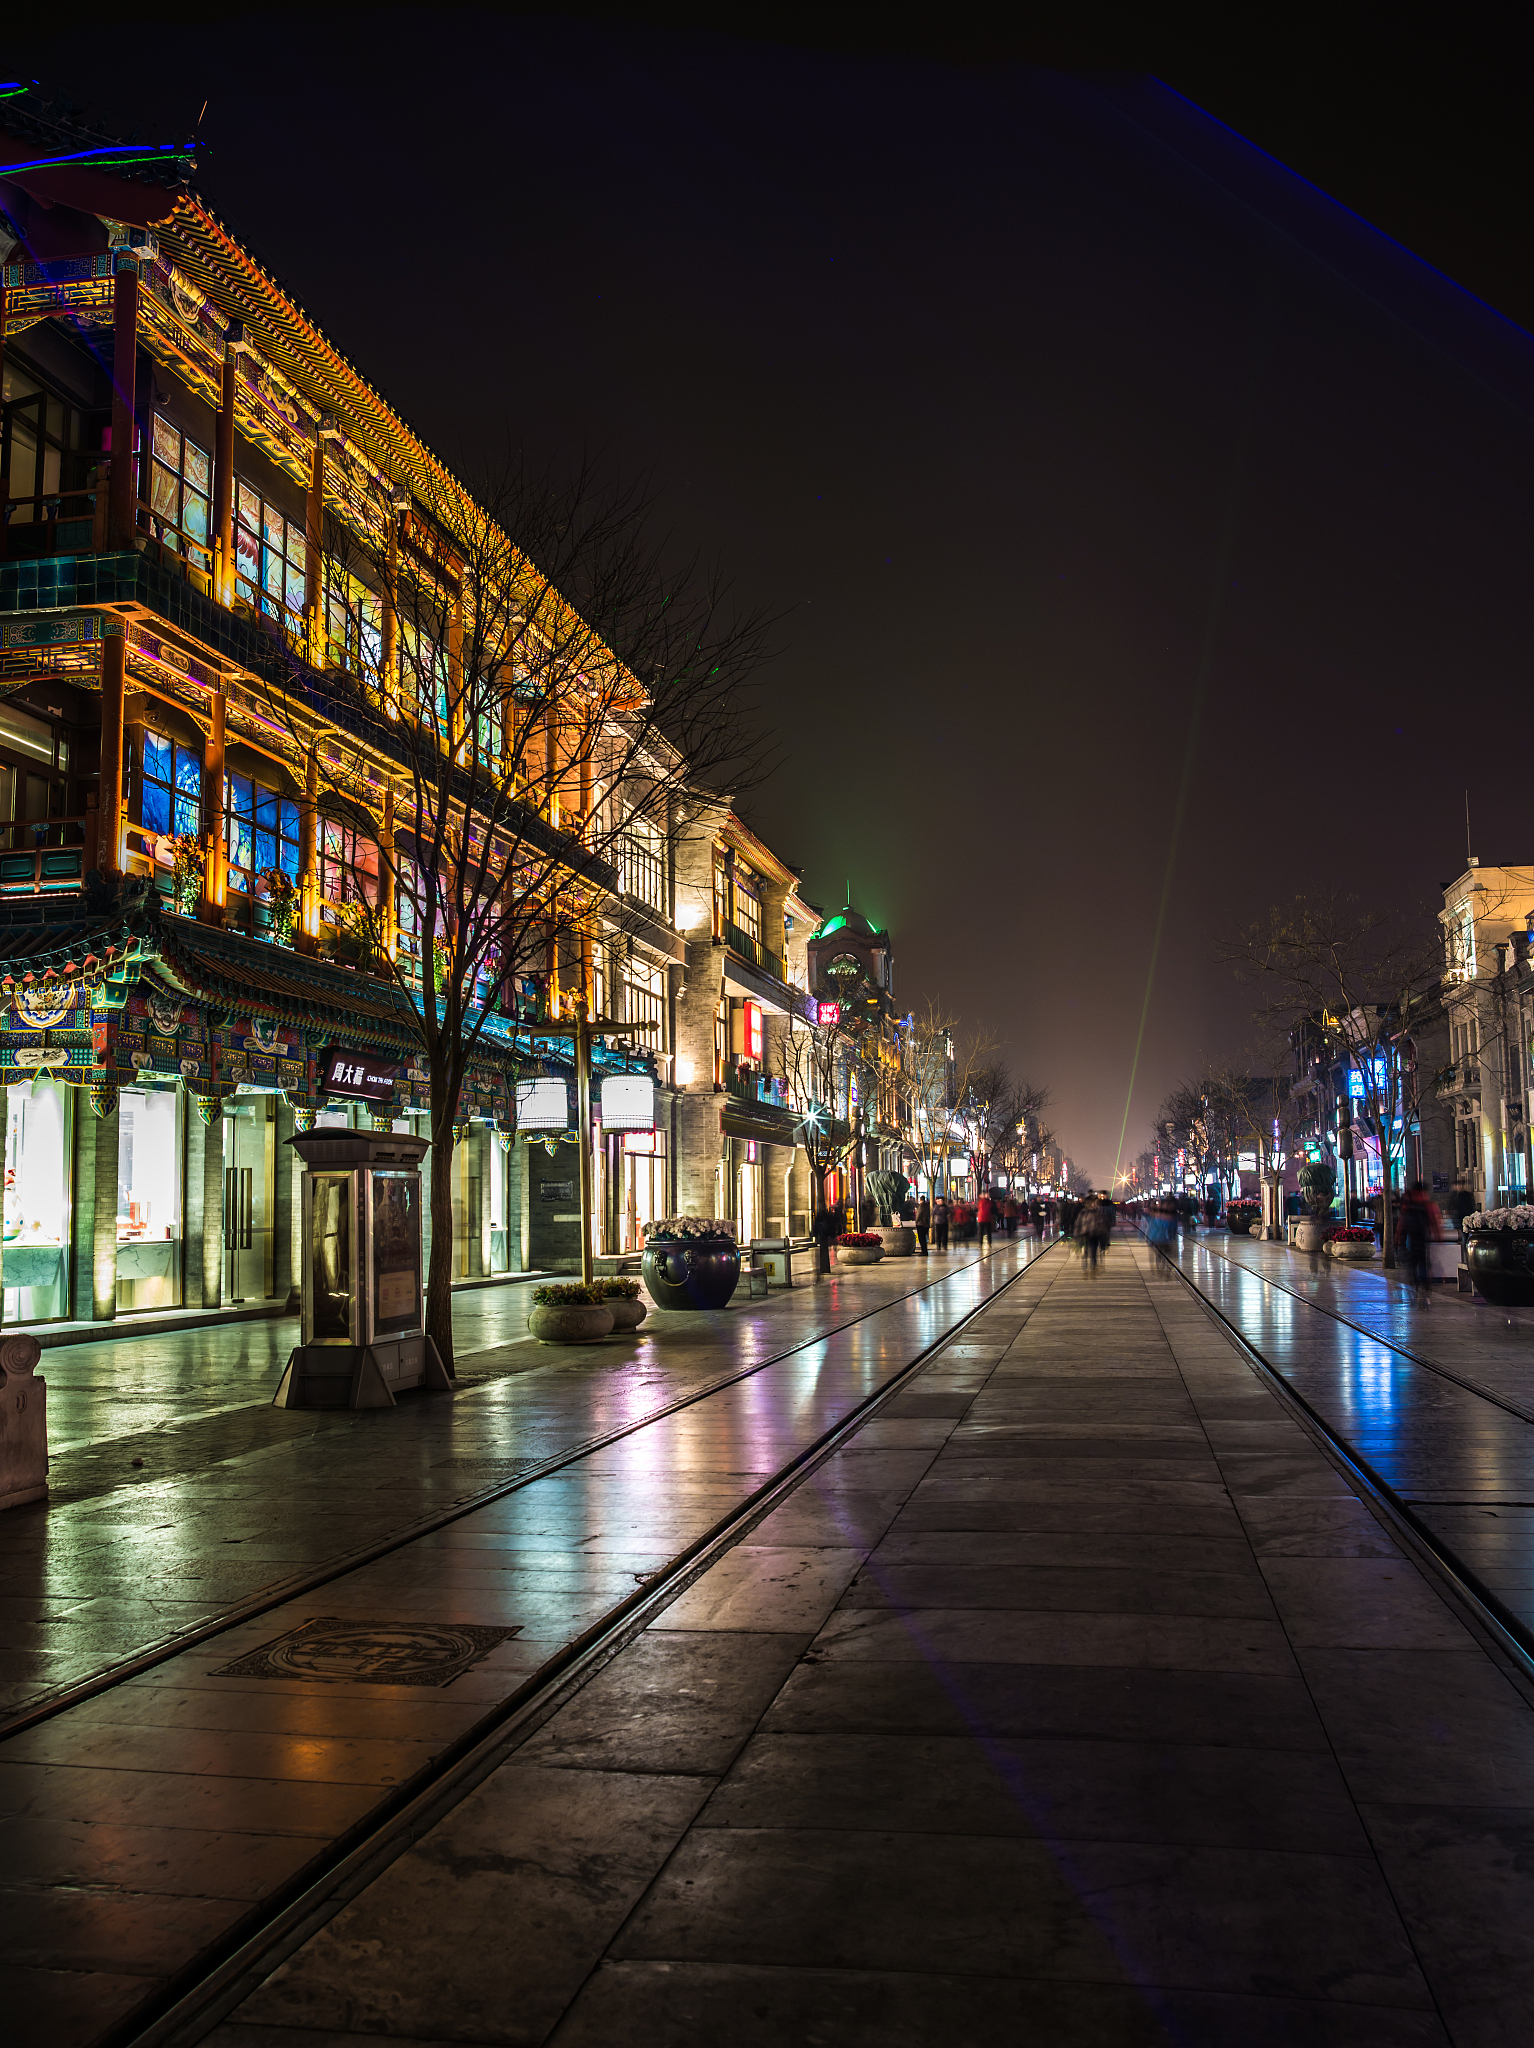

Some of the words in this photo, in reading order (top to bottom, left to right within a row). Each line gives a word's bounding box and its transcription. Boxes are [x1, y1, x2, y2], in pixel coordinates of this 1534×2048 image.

[331, 1062, 365, 1085] 周大福
[1350, 1070, 1364, 1096] 药店
